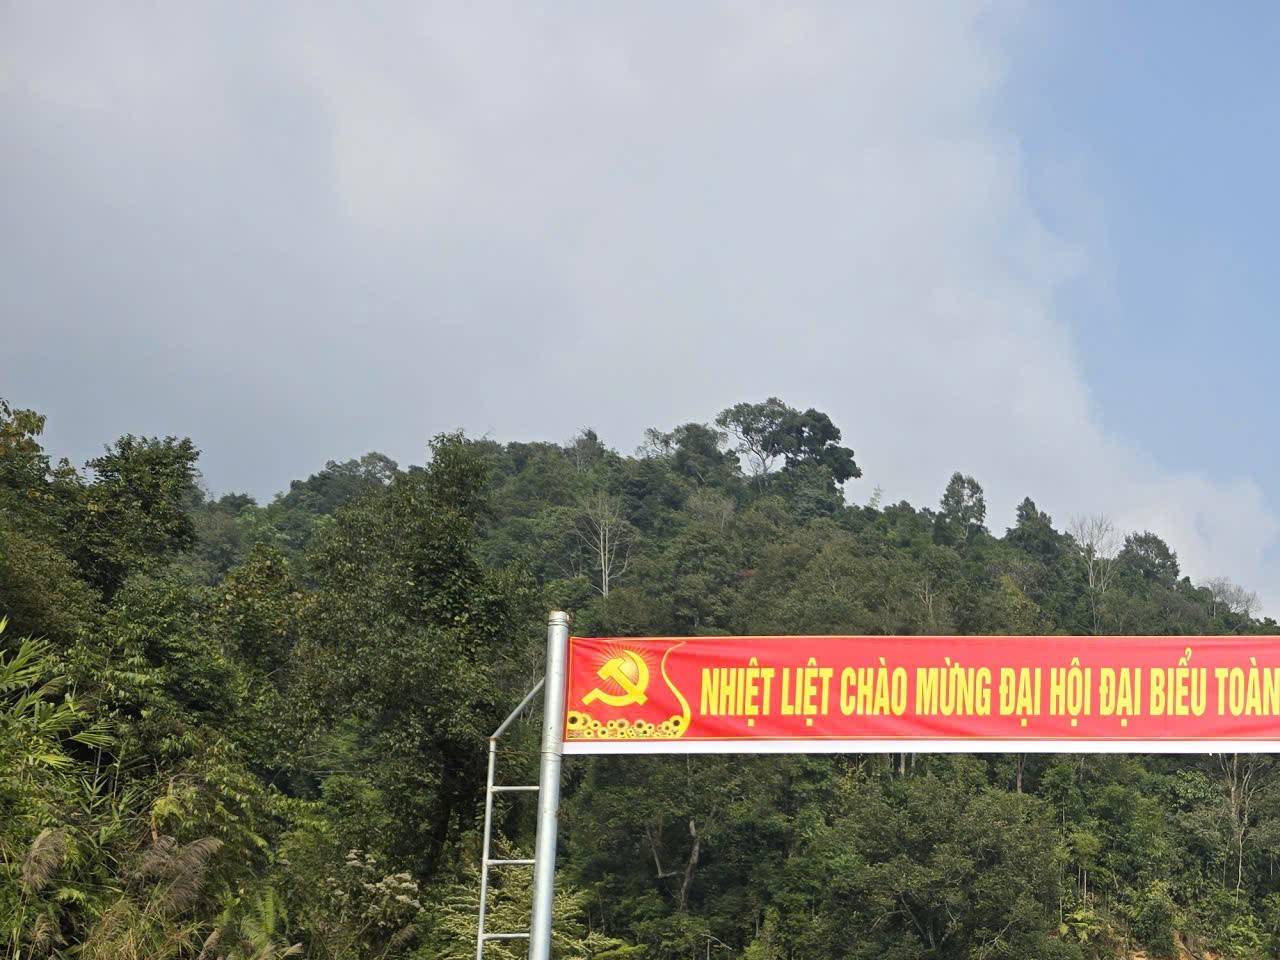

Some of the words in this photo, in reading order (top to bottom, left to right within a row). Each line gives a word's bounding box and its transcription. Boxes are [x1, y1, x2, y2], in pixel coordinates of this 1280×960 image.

[701, 657, 773, 727] NHIỆT
[781, 657, 833, 727] LIỆT
[840, 657, 907, 716] CHÀO
[916, 658, 992, 716] MỪNG
[999, 667, 1041, 727] ĐẠI
[1050, 657, 1091, 727] HỘI
[1099, 667, 1141, 727] ĐẠI
[1150, 647, 1207, 716] BIỂU
[1215, 656, 1280, 716] TOÀN
